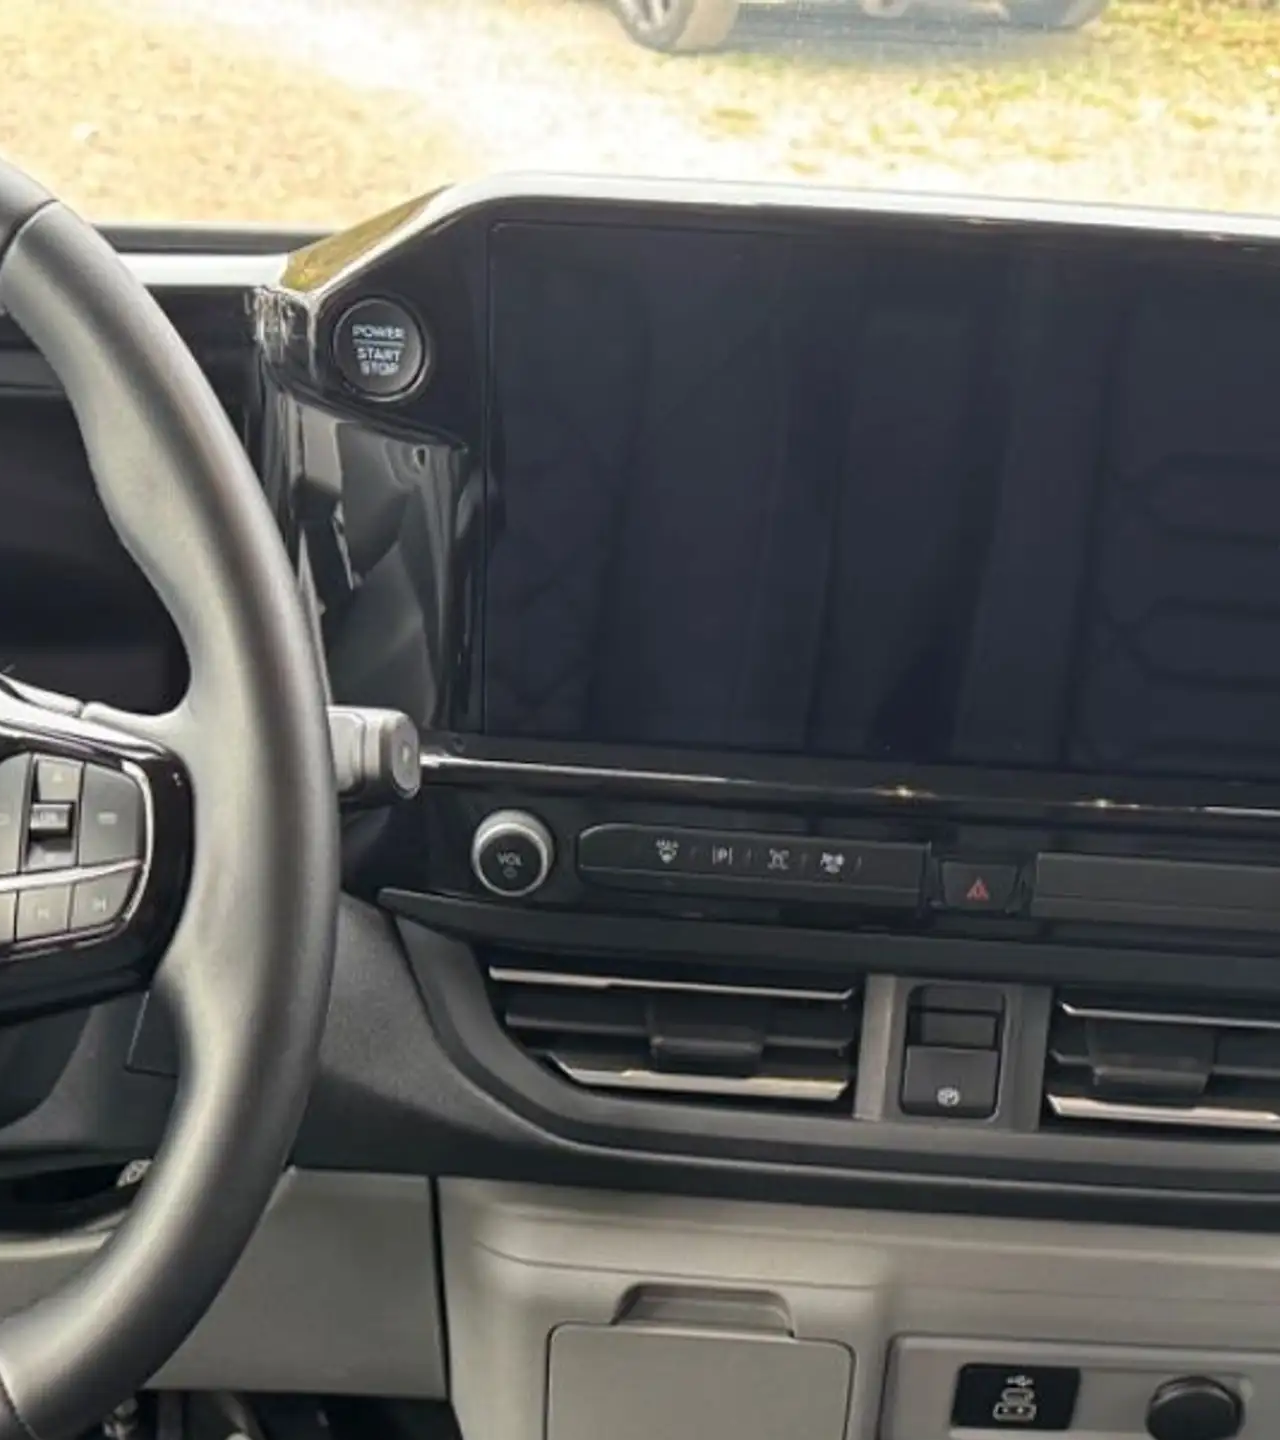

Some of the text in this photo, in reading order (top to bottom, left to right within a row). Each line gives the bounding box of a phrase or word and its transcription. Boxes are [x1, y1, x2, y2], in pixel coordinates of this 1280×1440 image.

[352, 324, 404, 339] POWER
[357, 347, 400, 361] START
[361, 360, 399, 375] STOP
